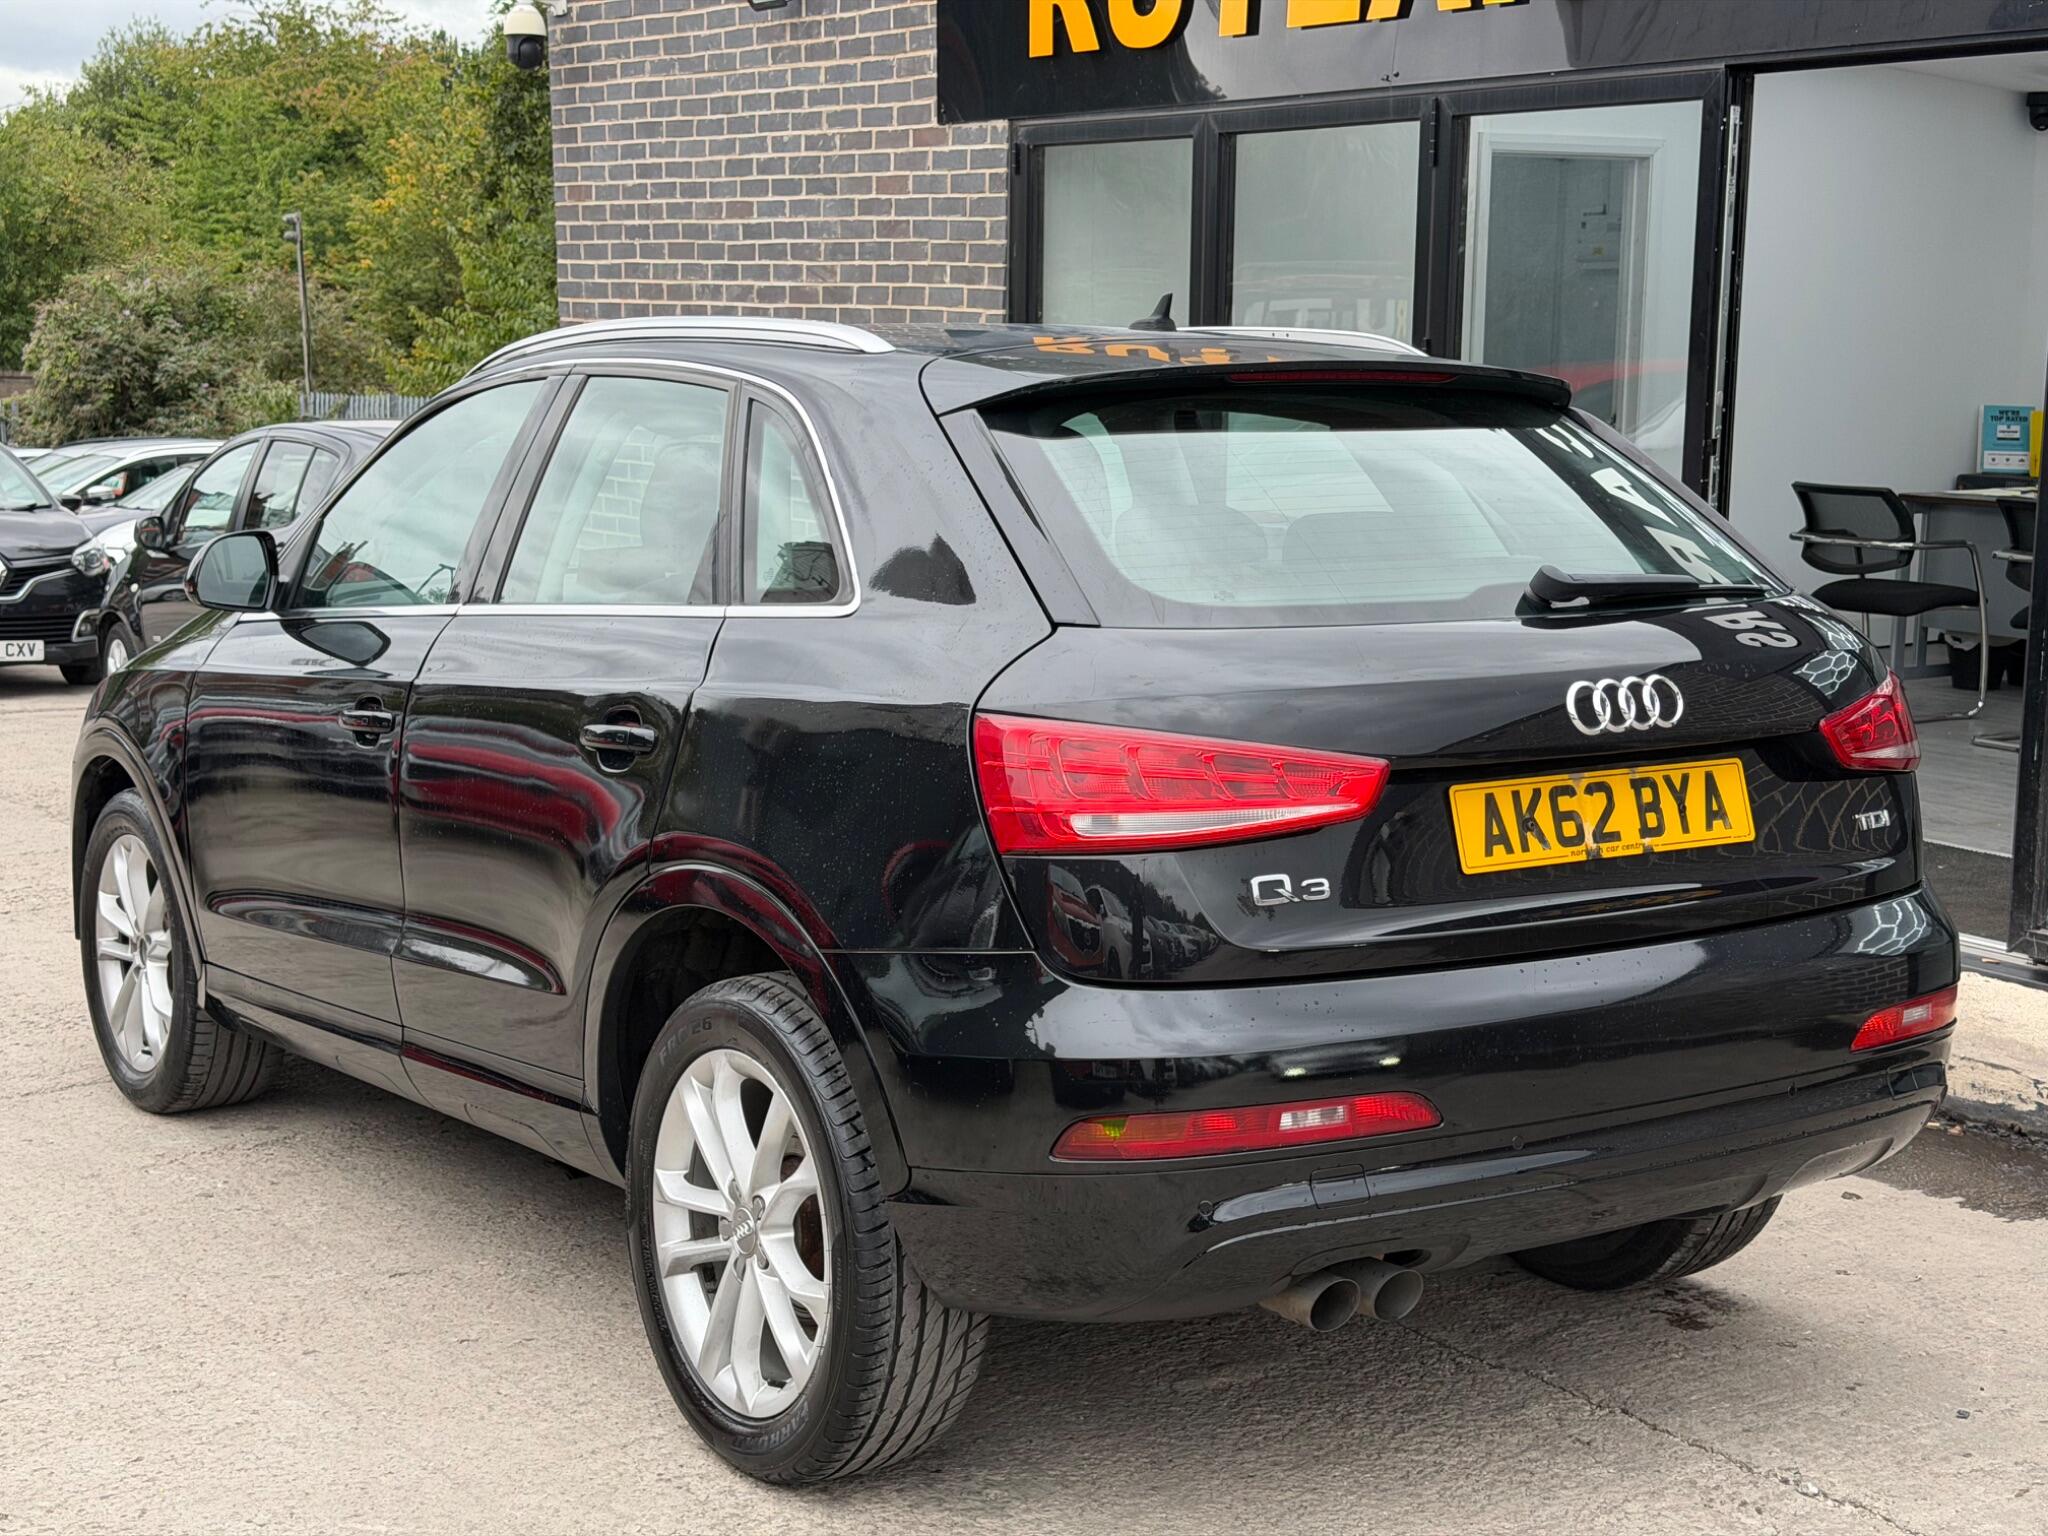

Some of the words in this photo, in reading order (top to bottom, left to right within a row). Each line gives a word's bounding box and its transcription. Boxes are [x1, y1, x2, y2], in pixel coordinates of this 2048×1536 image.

[5, 642, 36, 657] CXV
[1484, 781, 1622, 858] AK62
[1631, 769, 1733, 839] BYA
[1855, 809, 1891, 831] TDI
[1605, 844, 1620, 853] car
[1621, 841, 1651, 851] centr
[1250, 873, 1331, 906] Q3
